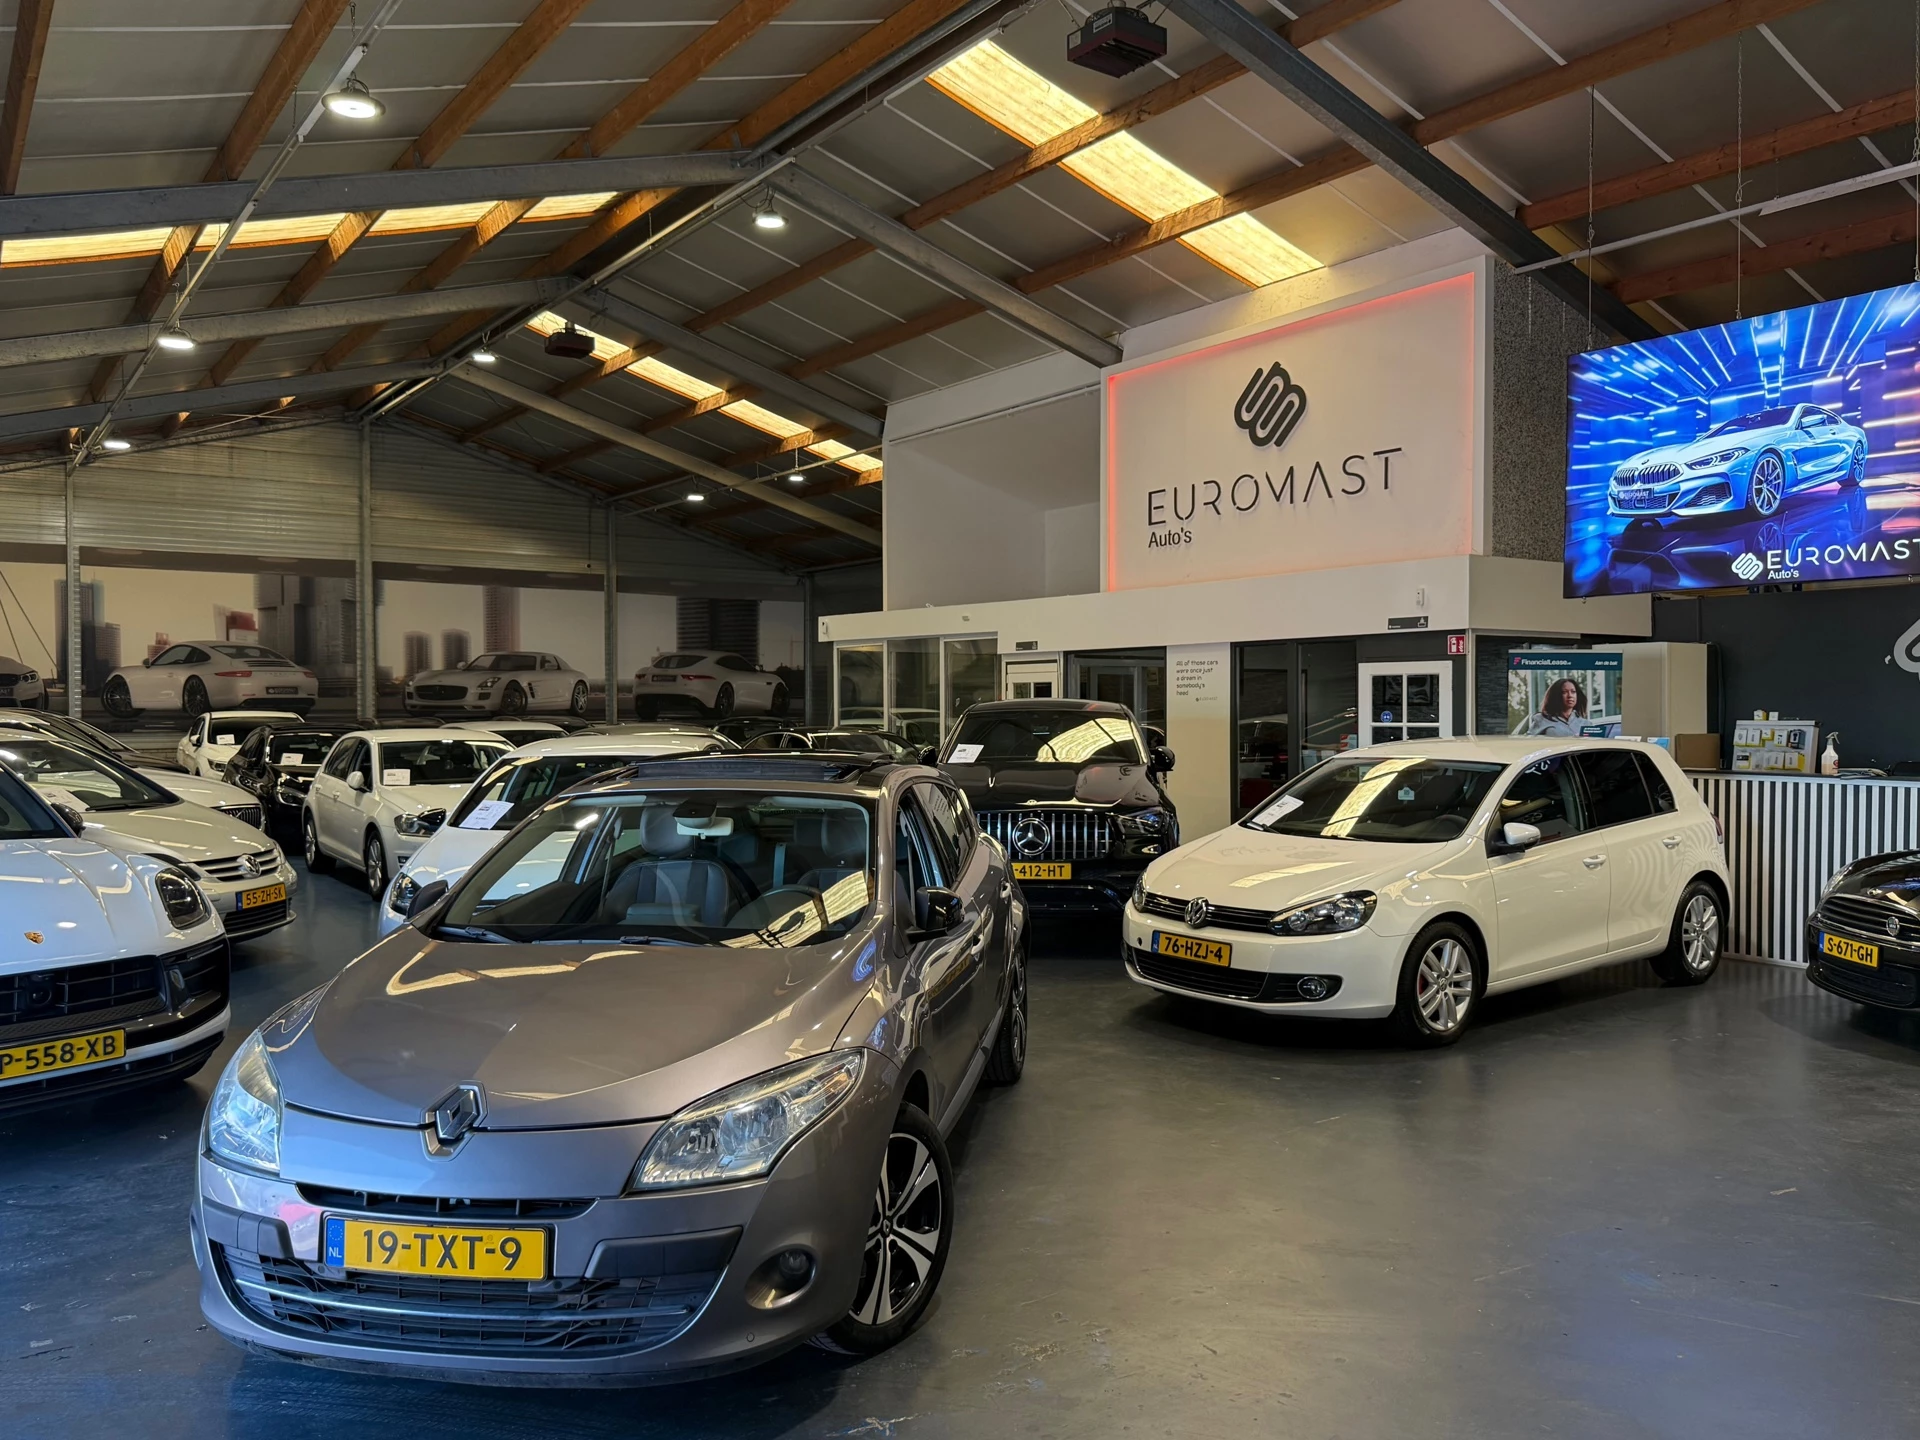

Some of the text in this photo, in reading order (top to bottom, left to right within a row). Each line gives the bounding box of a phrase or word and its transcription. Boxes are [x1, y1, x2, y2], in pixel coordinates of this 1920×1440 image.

[1147, 447, 1402, 526] EUROMAST
[1148, 527, 1192, 548] Auto's
[1768, 568, 1799, 580] Auto's
[1014, 864, 1065, 878] -412-HT
[246, 886, 283, 906] 55-ZH-SK
[1164, 936, 1223, 963] 76-HZJ-4
[1827, 937, 1873, 964] S-671-GH
[0, 1035, 116, 1075] P-558-XB
[328, 1229, 522, 1271] NL 19-TXT-9
